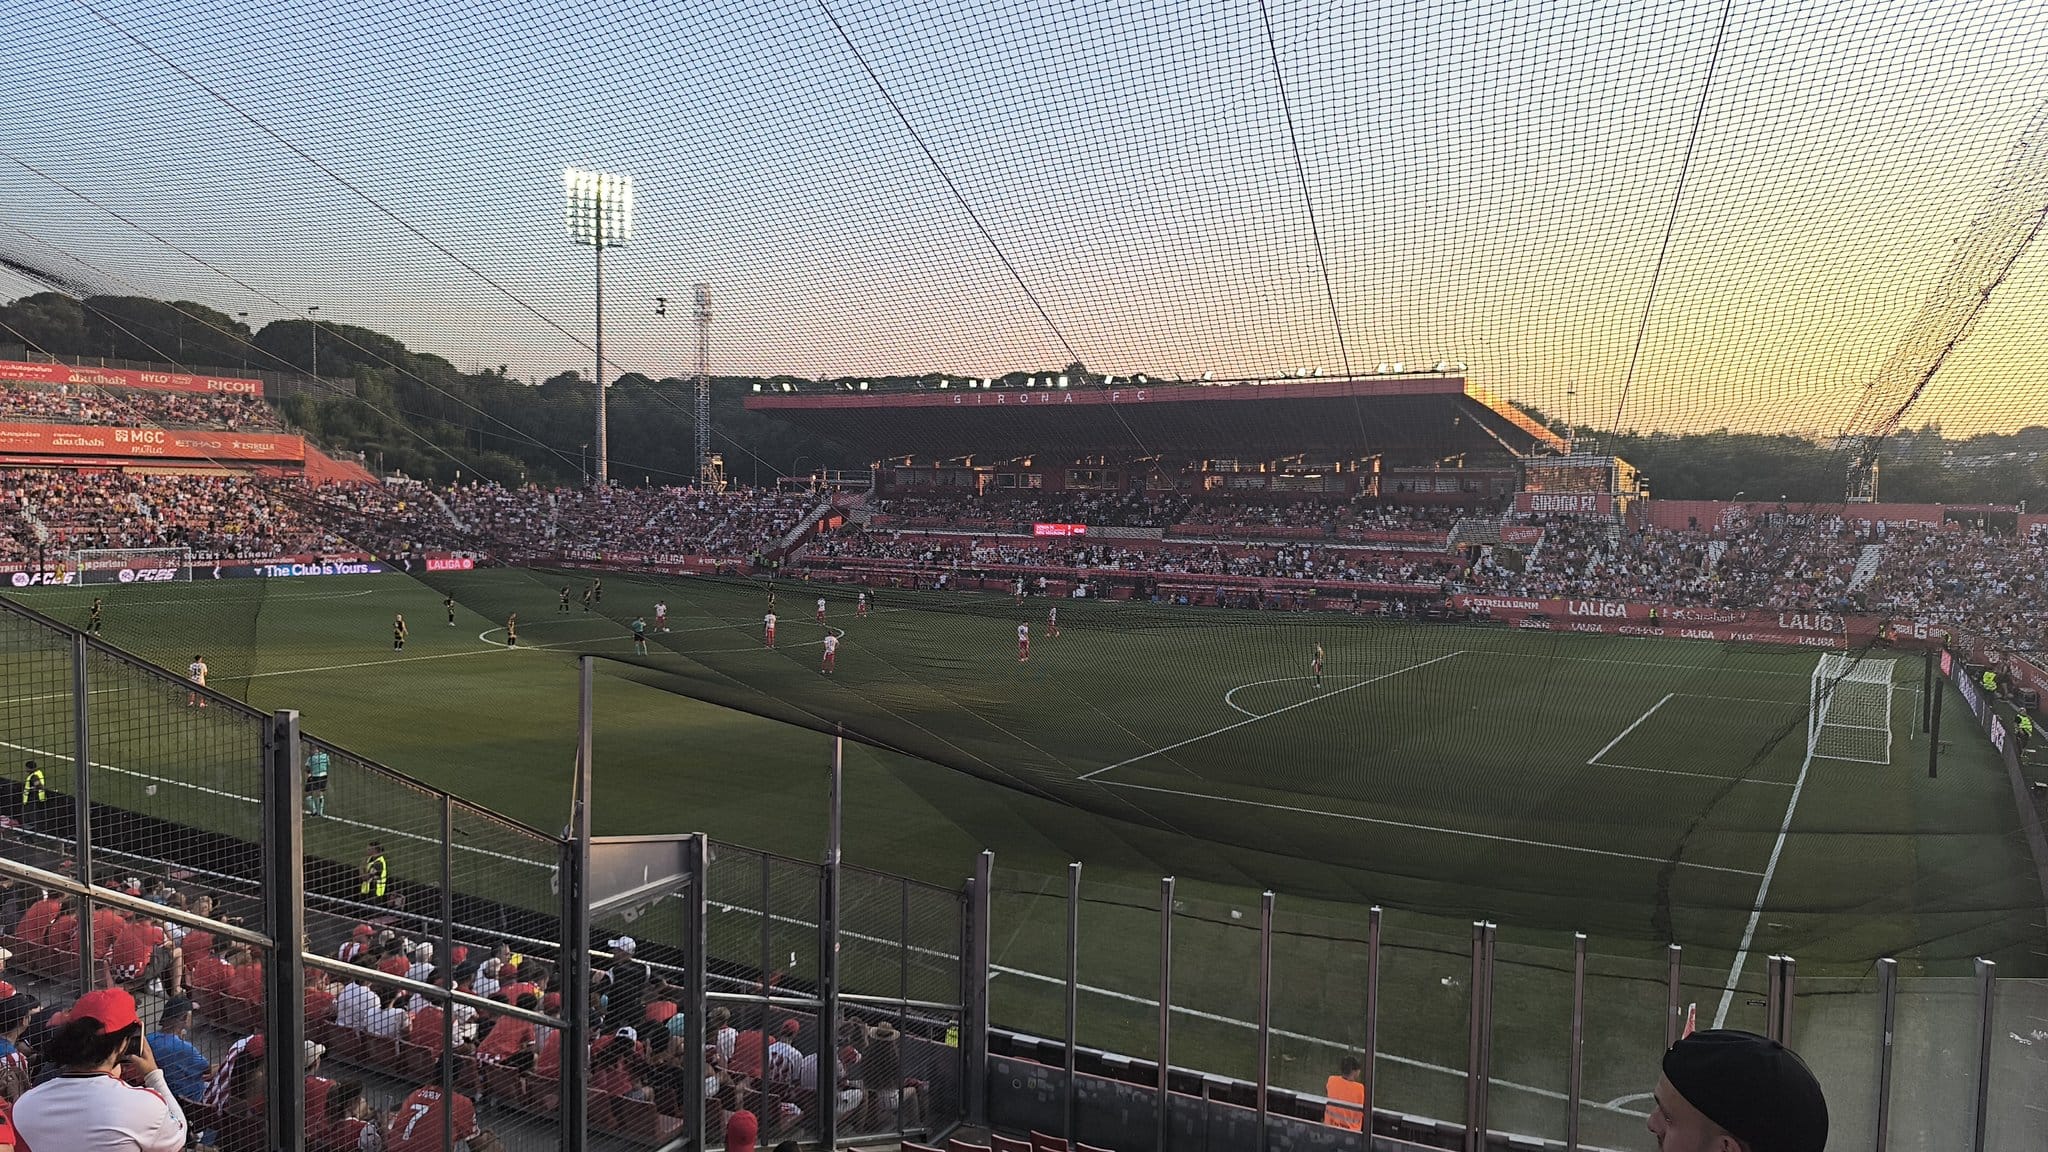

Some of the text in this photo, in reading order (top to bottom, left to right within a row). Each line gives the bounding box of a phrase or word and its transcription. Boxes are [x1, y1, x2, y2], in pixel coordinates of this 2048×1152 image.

[141, 373, 168, 384] HYLO
[207, 380, 255, 393] RICOH
[954, 391, 1145, 403] GIRONA FC
[52, 438, 104, 447] abu dhabi
[131, 430, 164, 443] MGC
[175, 440, 222, 449] ETIHAD
[1531, 495, 1596, 511] GIRONA FC
[564, 550, 597, 560] LALIGA
[654, 554, 685, 564] LALIGA
[265, 563, 368, 577] The Club is Yours
[428, 559, 460, 570] LALIGA
[1569, 600, 1627, 618] LALIGA
[402, 1103, 430, 1141] 7
